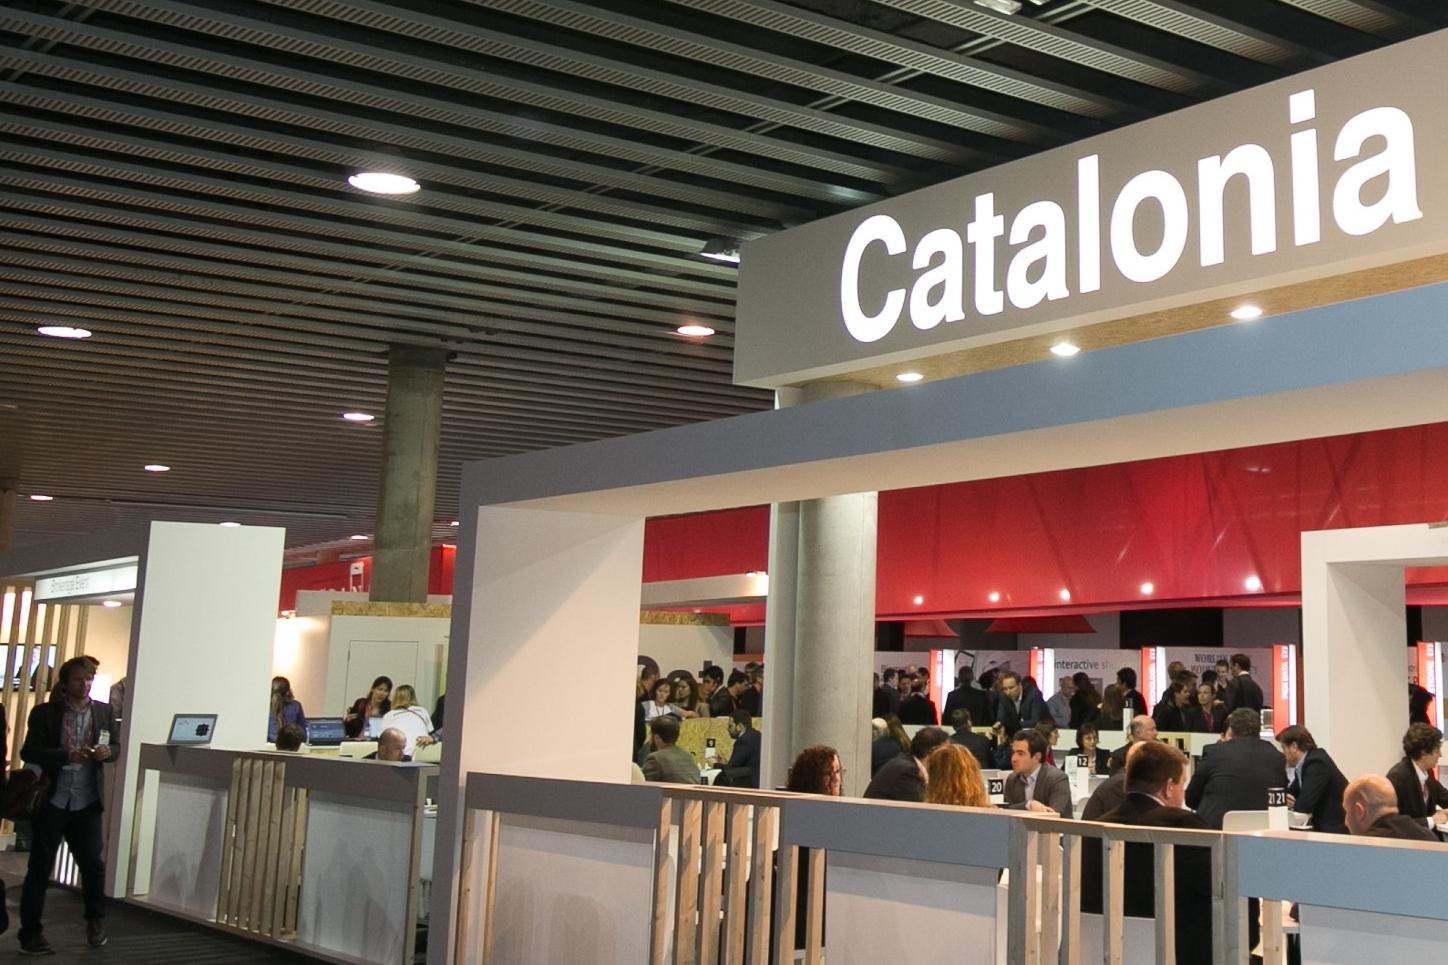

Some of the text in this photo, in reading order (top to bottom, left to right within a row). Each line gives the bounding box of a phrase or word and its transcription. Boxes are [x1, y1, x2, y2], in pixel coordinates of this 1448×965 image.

[841, 89, 1423, 344] Catalonia
[1078, 756, 1088, 767] 12
[991, 781, 1003, 793] 20
[1276, 792, 1286, 805] 21
